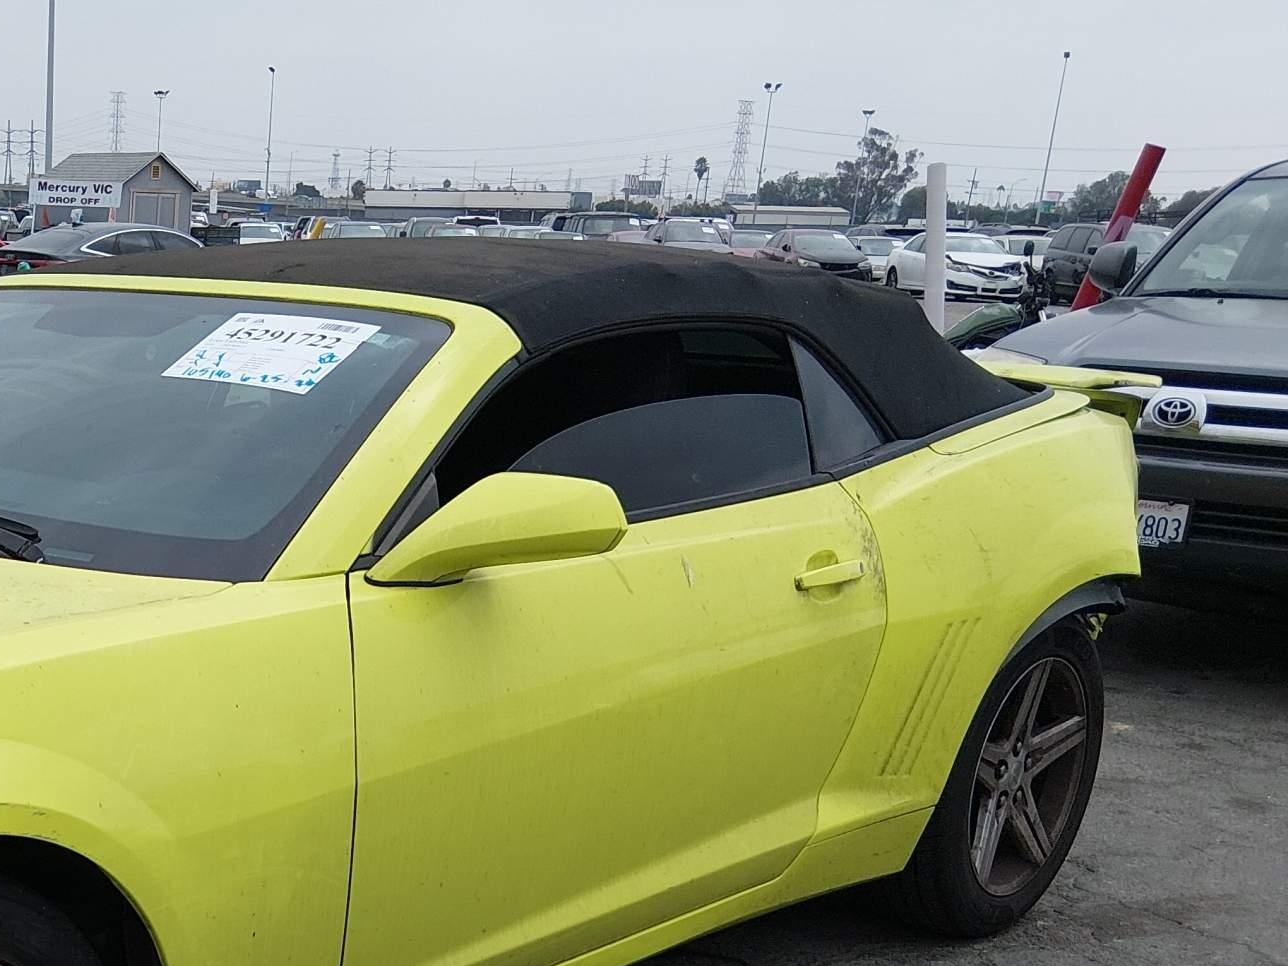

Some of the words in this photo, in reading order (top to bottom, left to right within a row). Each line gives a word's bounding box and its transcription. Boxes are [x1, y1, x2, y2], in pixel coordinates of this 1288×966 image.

[37, 181, 88, 195] Mercury
[93, 183, 113, 194] VIC
[48, 196, 77, 204] DROP
[225, 327, 342, 349] 45291722
[1138, 514, 1182, 540] 803
